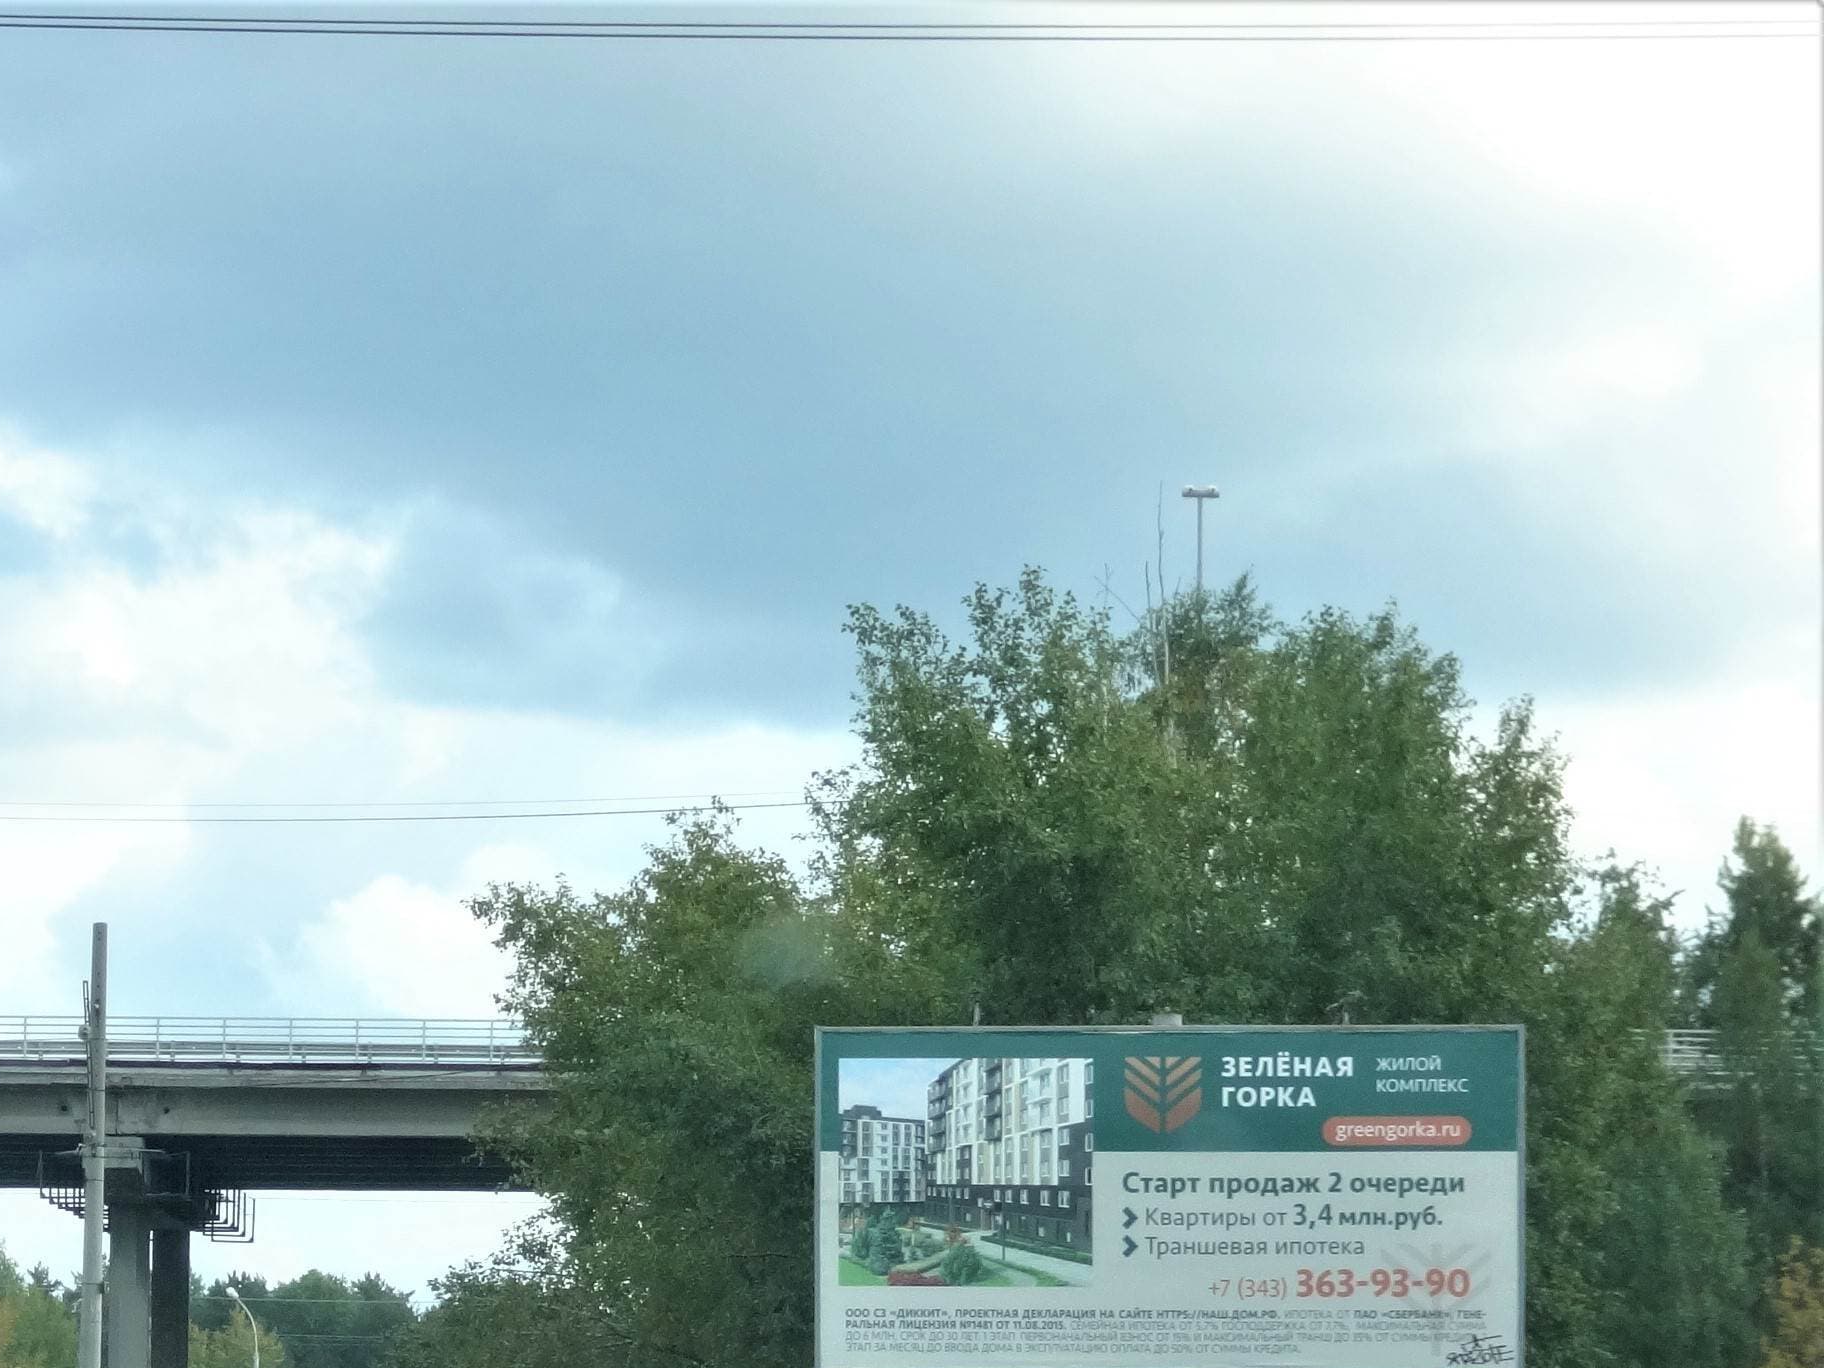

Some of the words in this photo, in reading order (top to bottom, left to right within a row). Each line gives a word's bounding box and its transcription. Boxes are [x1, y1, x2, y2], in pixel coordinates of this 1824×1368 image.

[1221, 1052, 1353, 1077] ЗЕЛЁНАЯ
[1376, 1055, 1441, 1071] ЖИЛОЙ
[1376, 1078, 1469, 1093] КОМПЛЕКС
[1221, 1087, 1316, 1107] ГОРКА
[1335, 1121, 1461, 1141] greengorka.ru
[1122, 1172, 1200, 1198] Старт
[1209, 1176, 1320, 1198] продаж
[1328, 1172, 1342, 1193] 2
[1350, 1175, 1465, 1198] очереди
[1145, 1207, 1256, 1230] Квартиры
[1263, 1211, 1288, 1225] от
[1293, 1203, 1333, 1230] 3,4
[1339, 1206, 1443, 1231] млн.руб.
[1144, 1236, 1267, 1259] Траншевая
[1275, 1240, 1365, 1259] ипотека
[1208, 1278, 1231, 1296] +7
[1237, 1277, 1288, 1300] (343)
[1296, 1267, 1471, 1299] 363-93-90
[845, 1308, 870, 1318] ООО
[873, 1308, 887, 1318] СЗ
[955, 1308, 1019, 1318] ПРОЕКТНАЯ
[1022, 1309, 1096, 1320] ДЕКЛАРАЦИЯ
[1099, 1309, 1115, 1319] НА
[1119, 1307, 1153, 1319] САЙТЕ
[1354, 1310, 1377, 1320] ПАО
[845, 1320, 895, 1329] РАЛЬНАЯ
[899, 1320, 956, 1330] ЛИЦЕНЗИЯ
[996, 1321, 1010, 1330] ОТ
